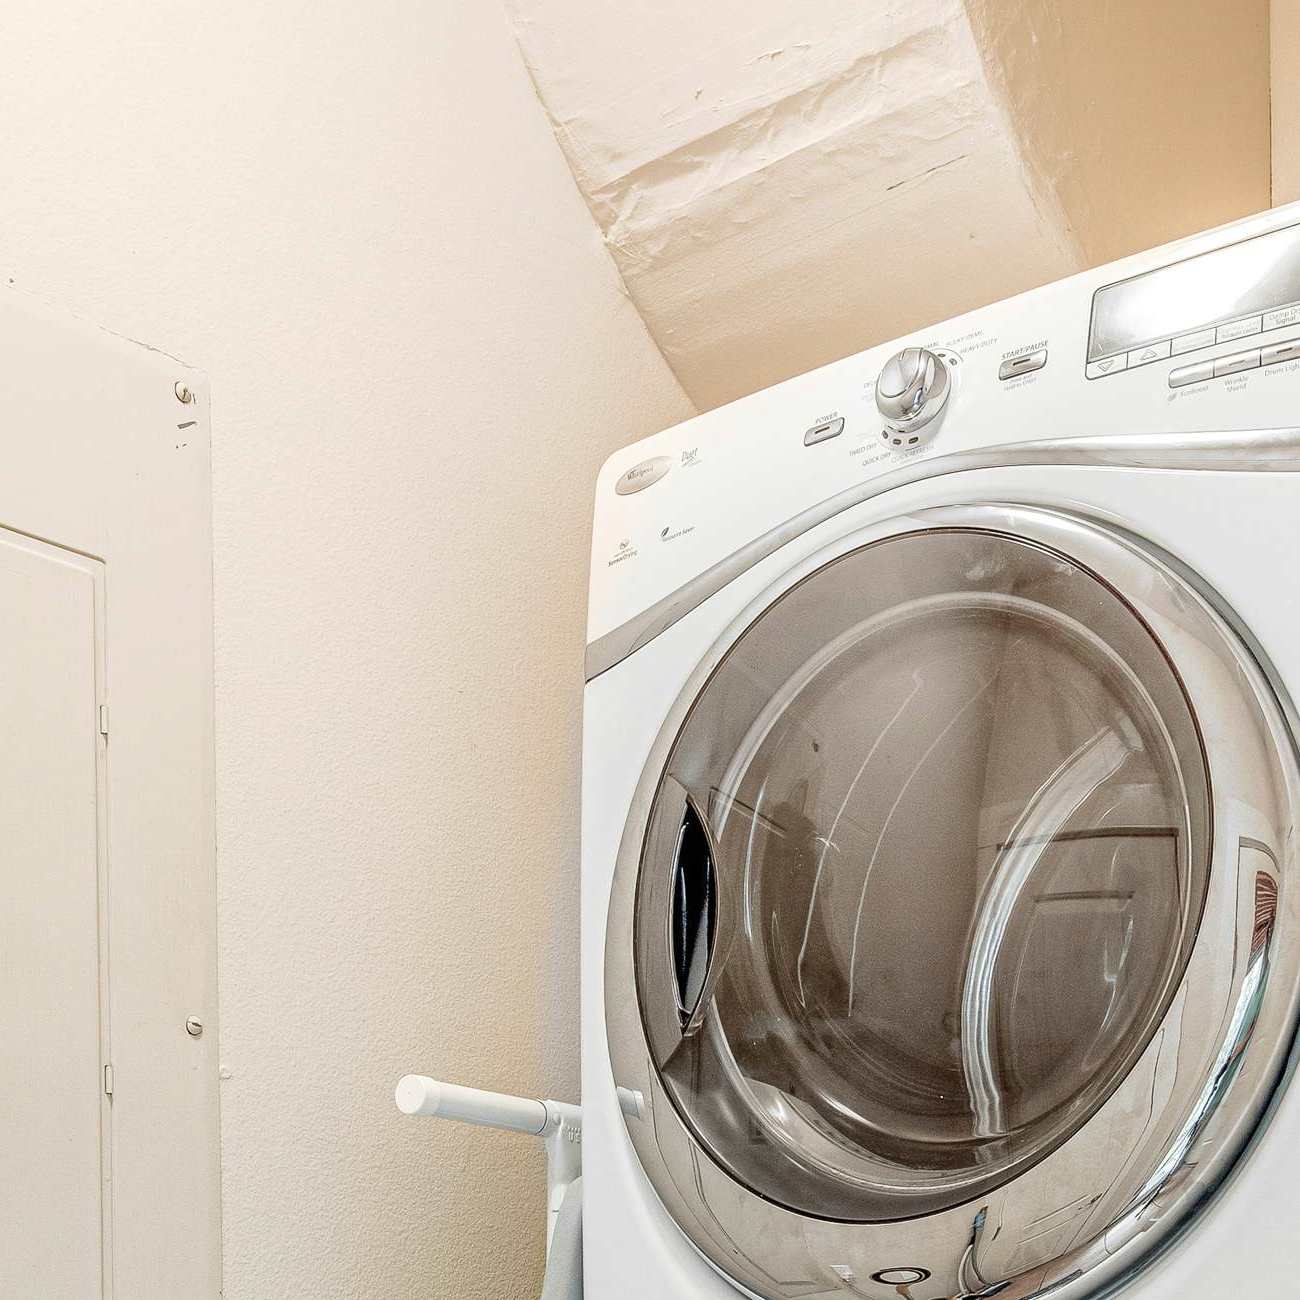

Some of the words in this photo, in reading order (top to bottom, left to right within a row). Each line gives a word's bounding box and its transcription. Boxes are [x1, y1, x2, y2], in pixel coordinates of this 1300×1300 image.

[960, 343, 979, 354] HEAVY
[1001, 339, 1048, 360] START/PAUSE
[1265, 367, 1284, 377] Drum
[815, 411, 838, 424] POWER
